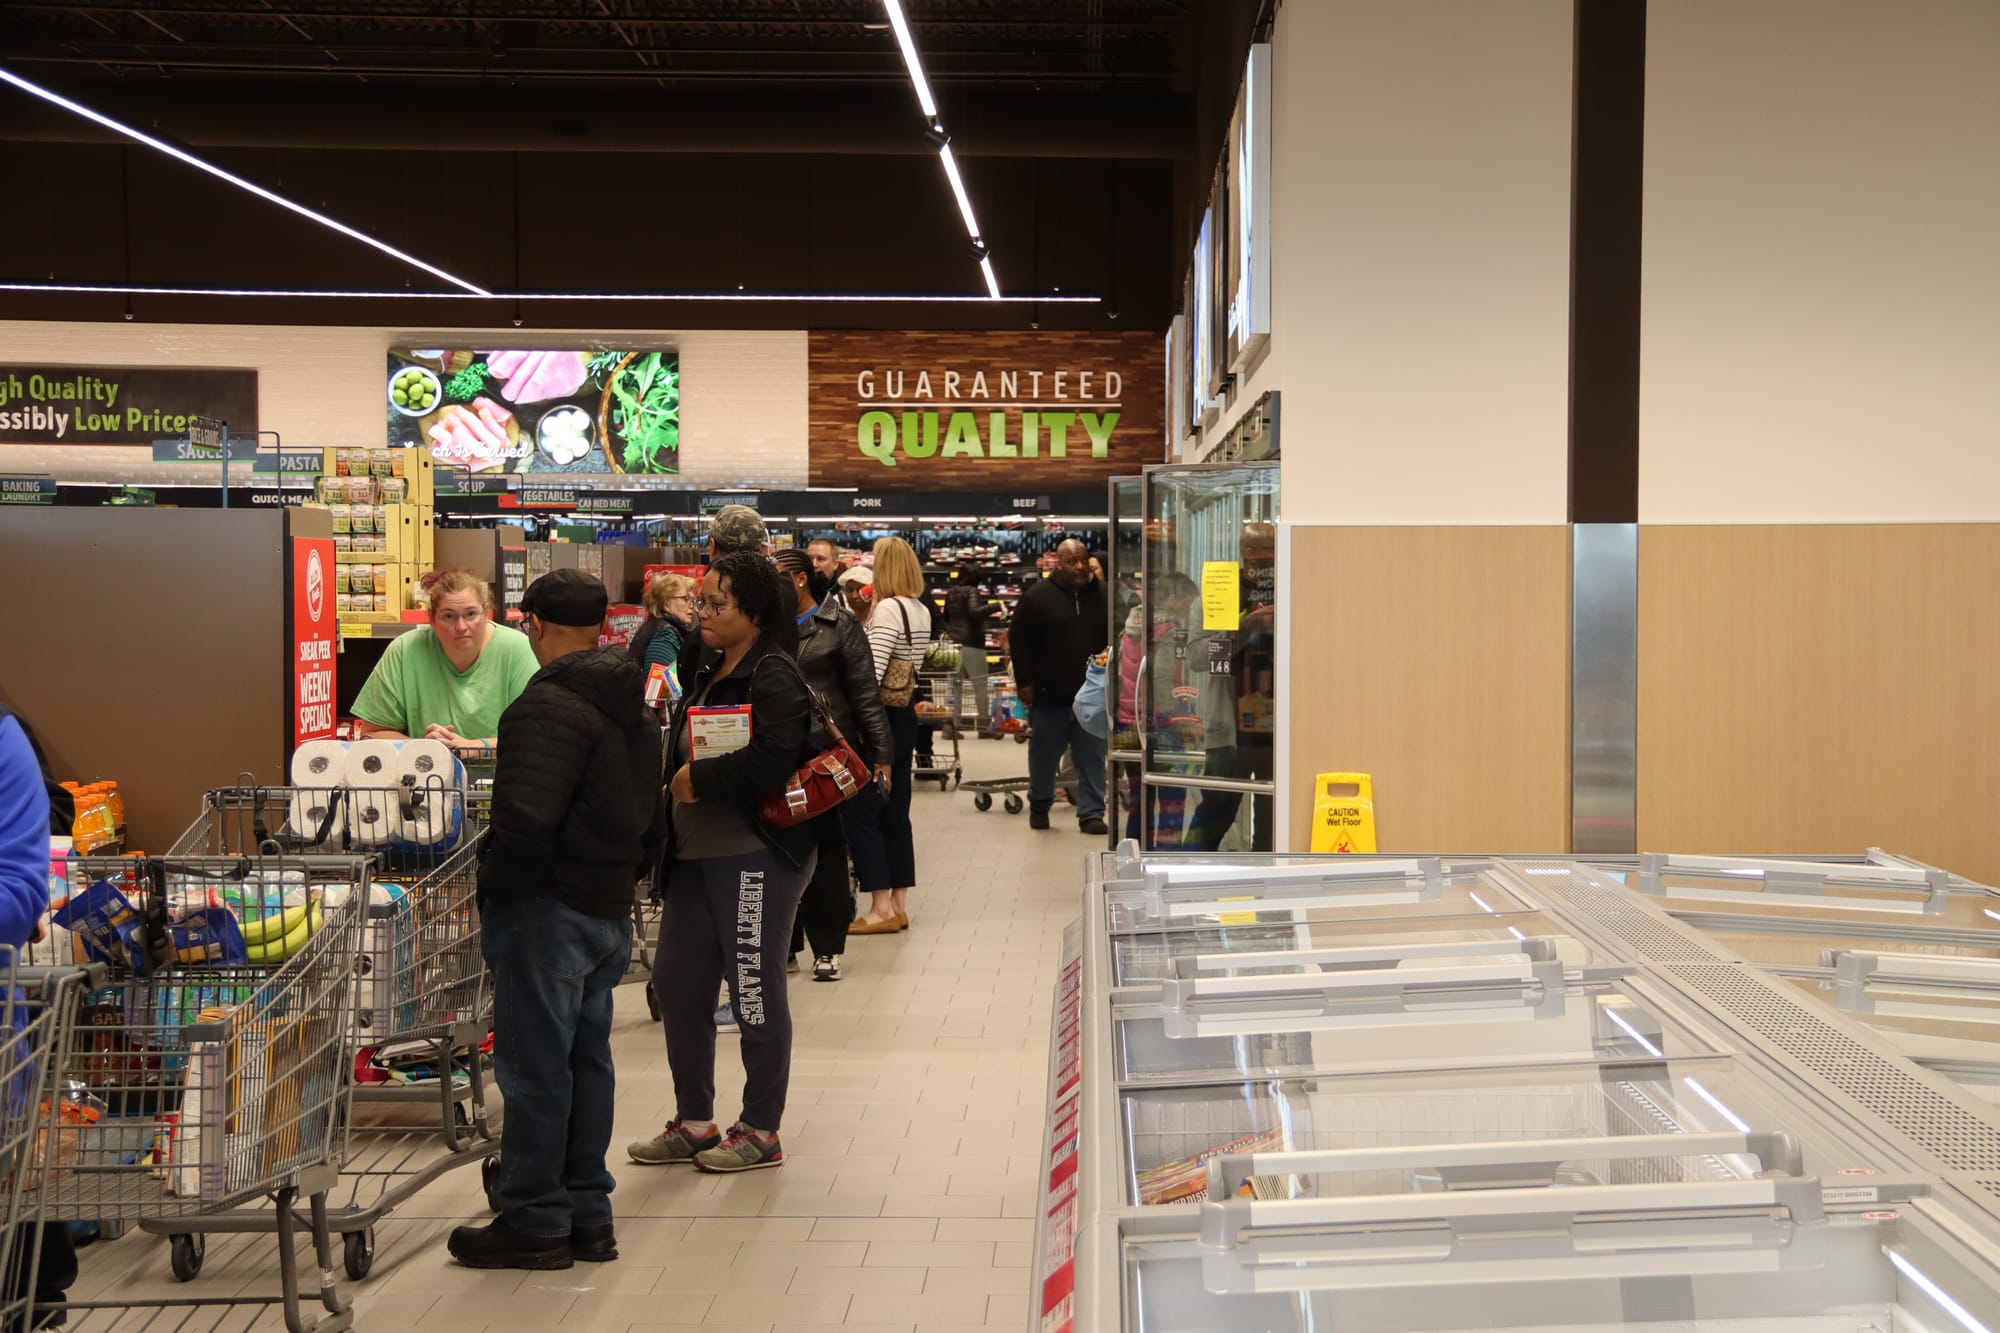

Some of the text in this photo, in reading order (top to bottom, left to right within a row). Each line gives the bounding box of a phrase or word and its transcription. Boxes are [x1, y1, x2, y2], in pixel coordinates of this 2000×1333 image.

[29, 374, 119, 408] Quality
[857, 370, 1122, 398] GUARANTEED
[75, 406, 121, 431] Low
[857, 410, 1121, 466] QUALITY
[280, 456, 320, 471] PASTA
[2, 481, 40, 492] BAKING
[521, 491, 575, 501] VEGETABLES
[610, 499, 631, 508] MEAT
[853, 498, 882, 507] PORK
[1013, 498, 1037, 508] BEEF
[300, 640, 331, 661] SNEAK PEEK
[300, 670, 332, 704] WEEKLY
[300, 703, 332, 734] SPECIALS
[1328, 808, 1360, 816] CAUTION
[1326, 817, 1362, 826] Wet Floor
[737, 871, 765, 1025] LIBERTY FLAMES
